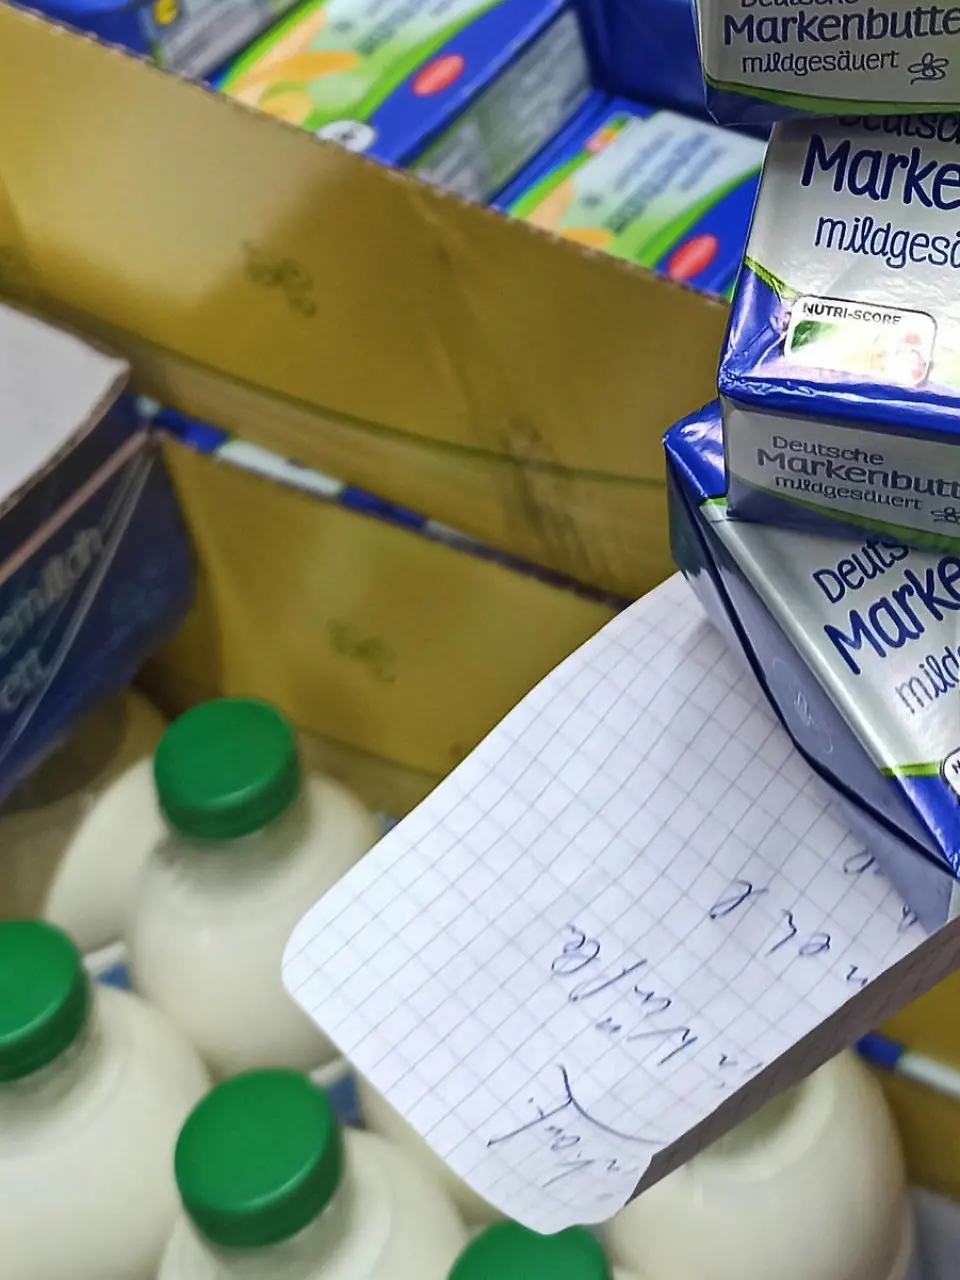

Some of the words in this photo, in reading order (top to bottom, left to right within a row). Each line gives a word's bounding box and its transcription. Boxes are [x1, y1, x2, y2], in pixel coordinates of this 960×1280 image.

[742, 50, 899, 76] mildgesäuert
[802, 302, 901, 325] NUTRI-SCORE
[773, 435, 884, 465] Deutsche
[775, 475, 922, 511] mildgesäuert
